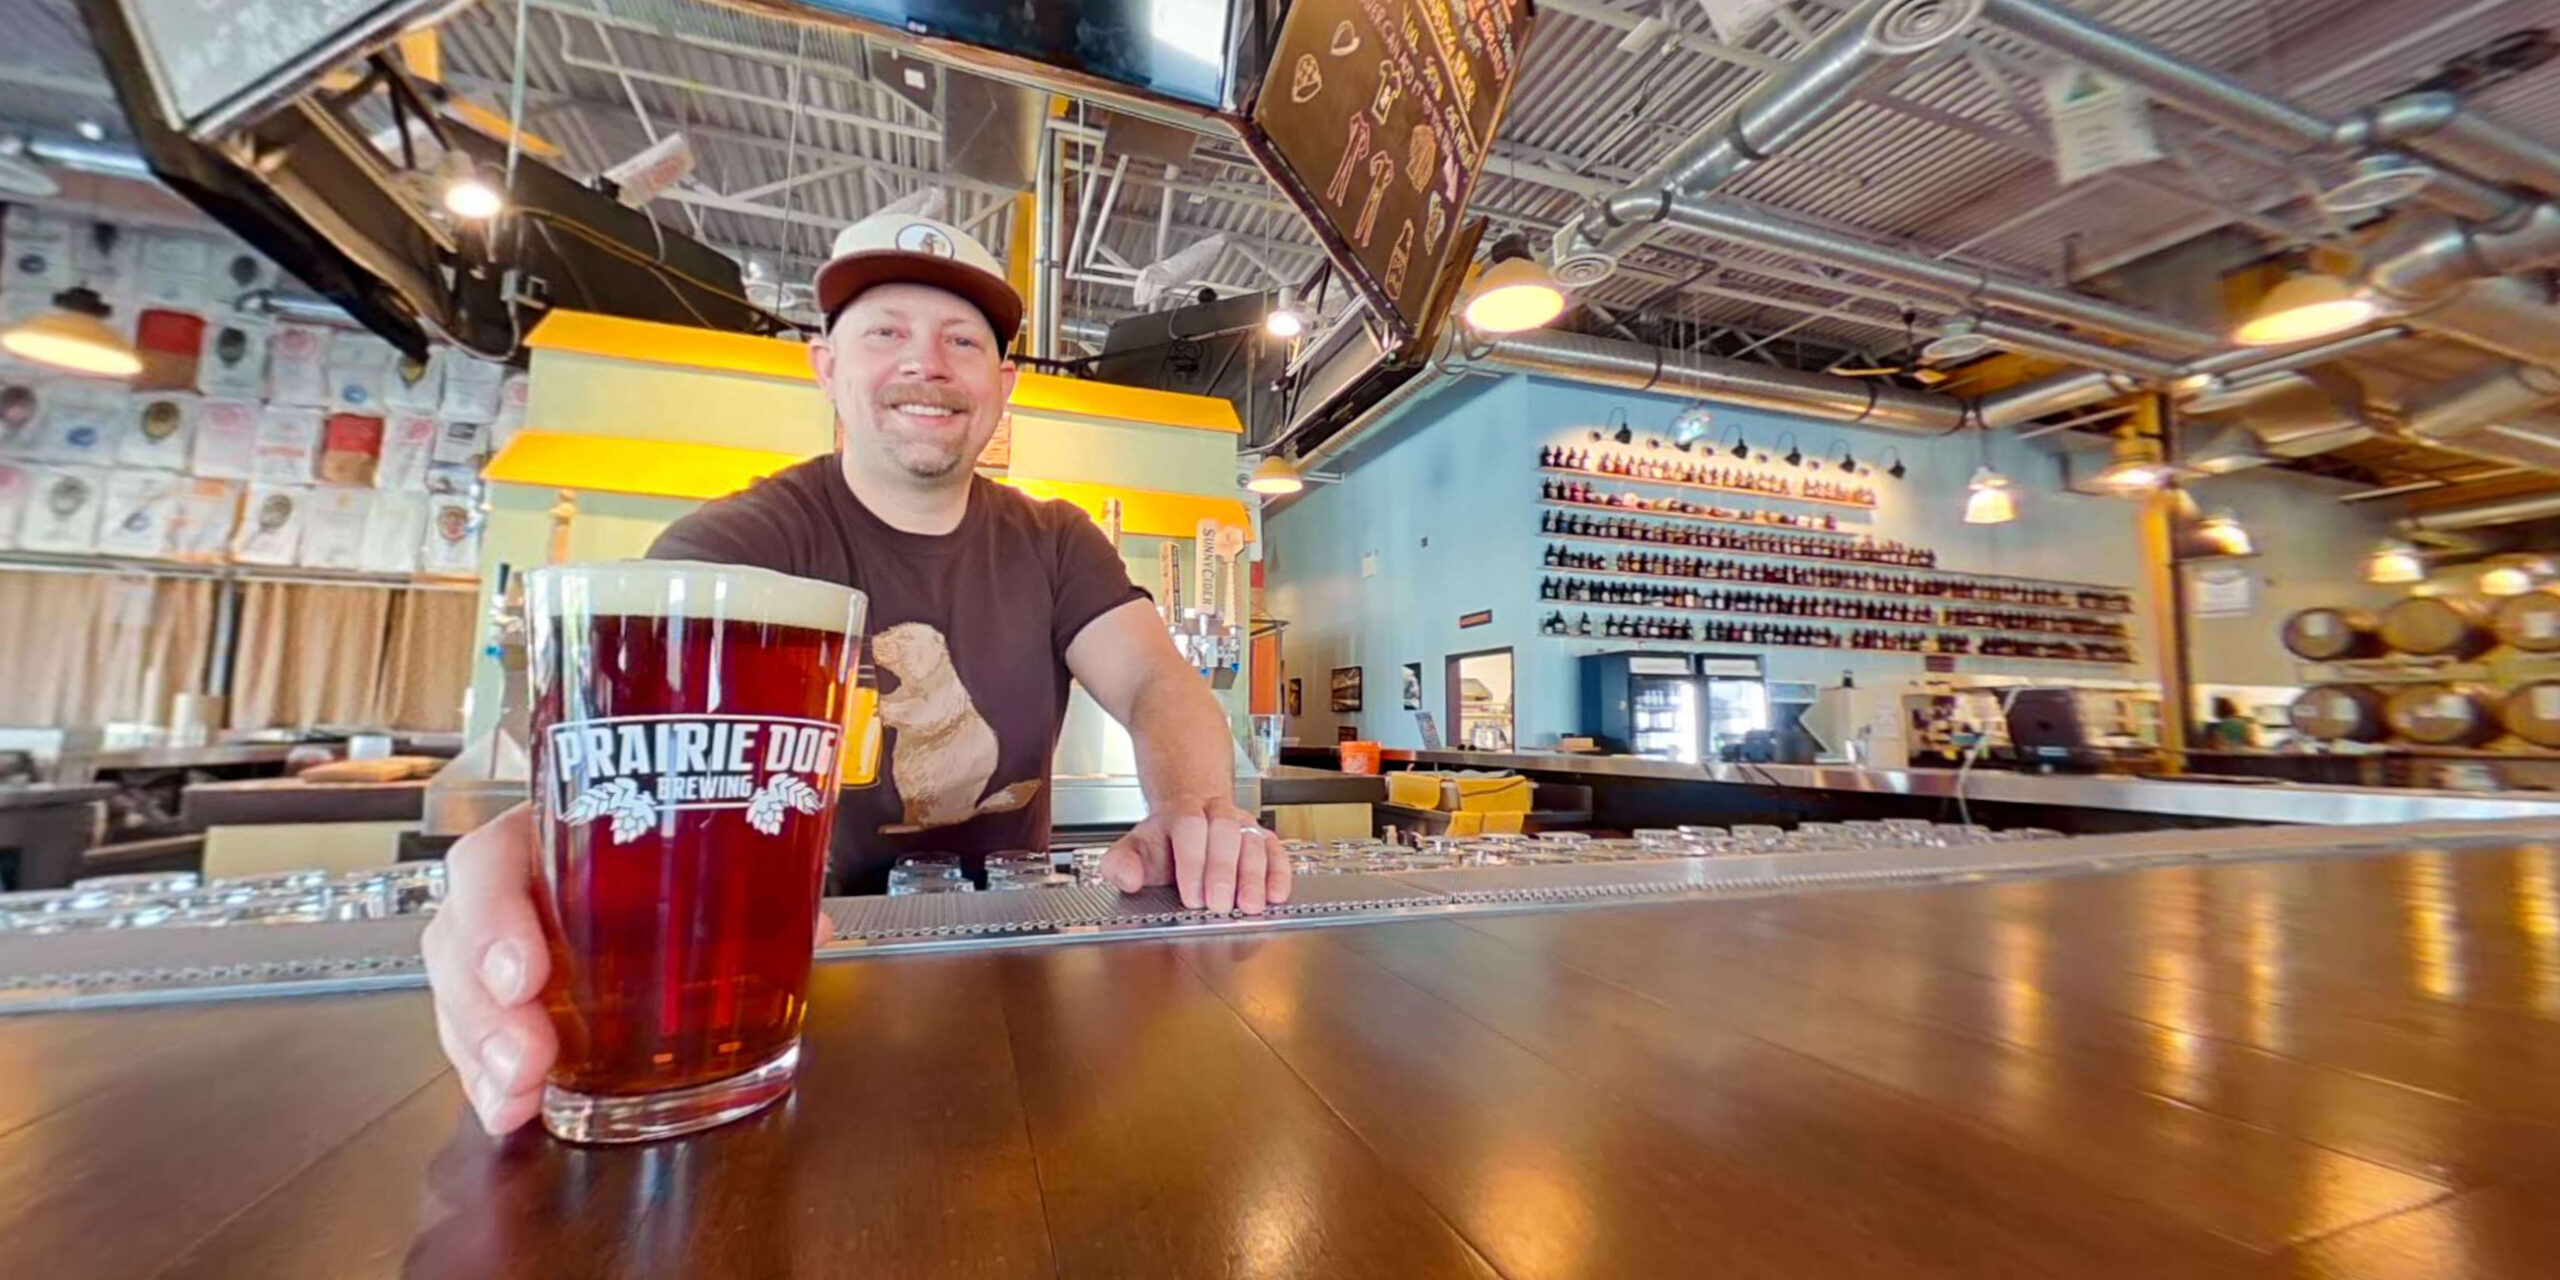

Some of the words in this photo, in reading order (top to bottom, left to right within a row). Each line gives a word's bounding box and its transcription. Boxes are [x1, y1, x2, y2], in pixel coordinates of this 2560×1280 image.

[555, 723, 759, 782] PRAIRIE
[764, 723, 837, 775] DOG
[656, 774, 754, 800] BREWING
